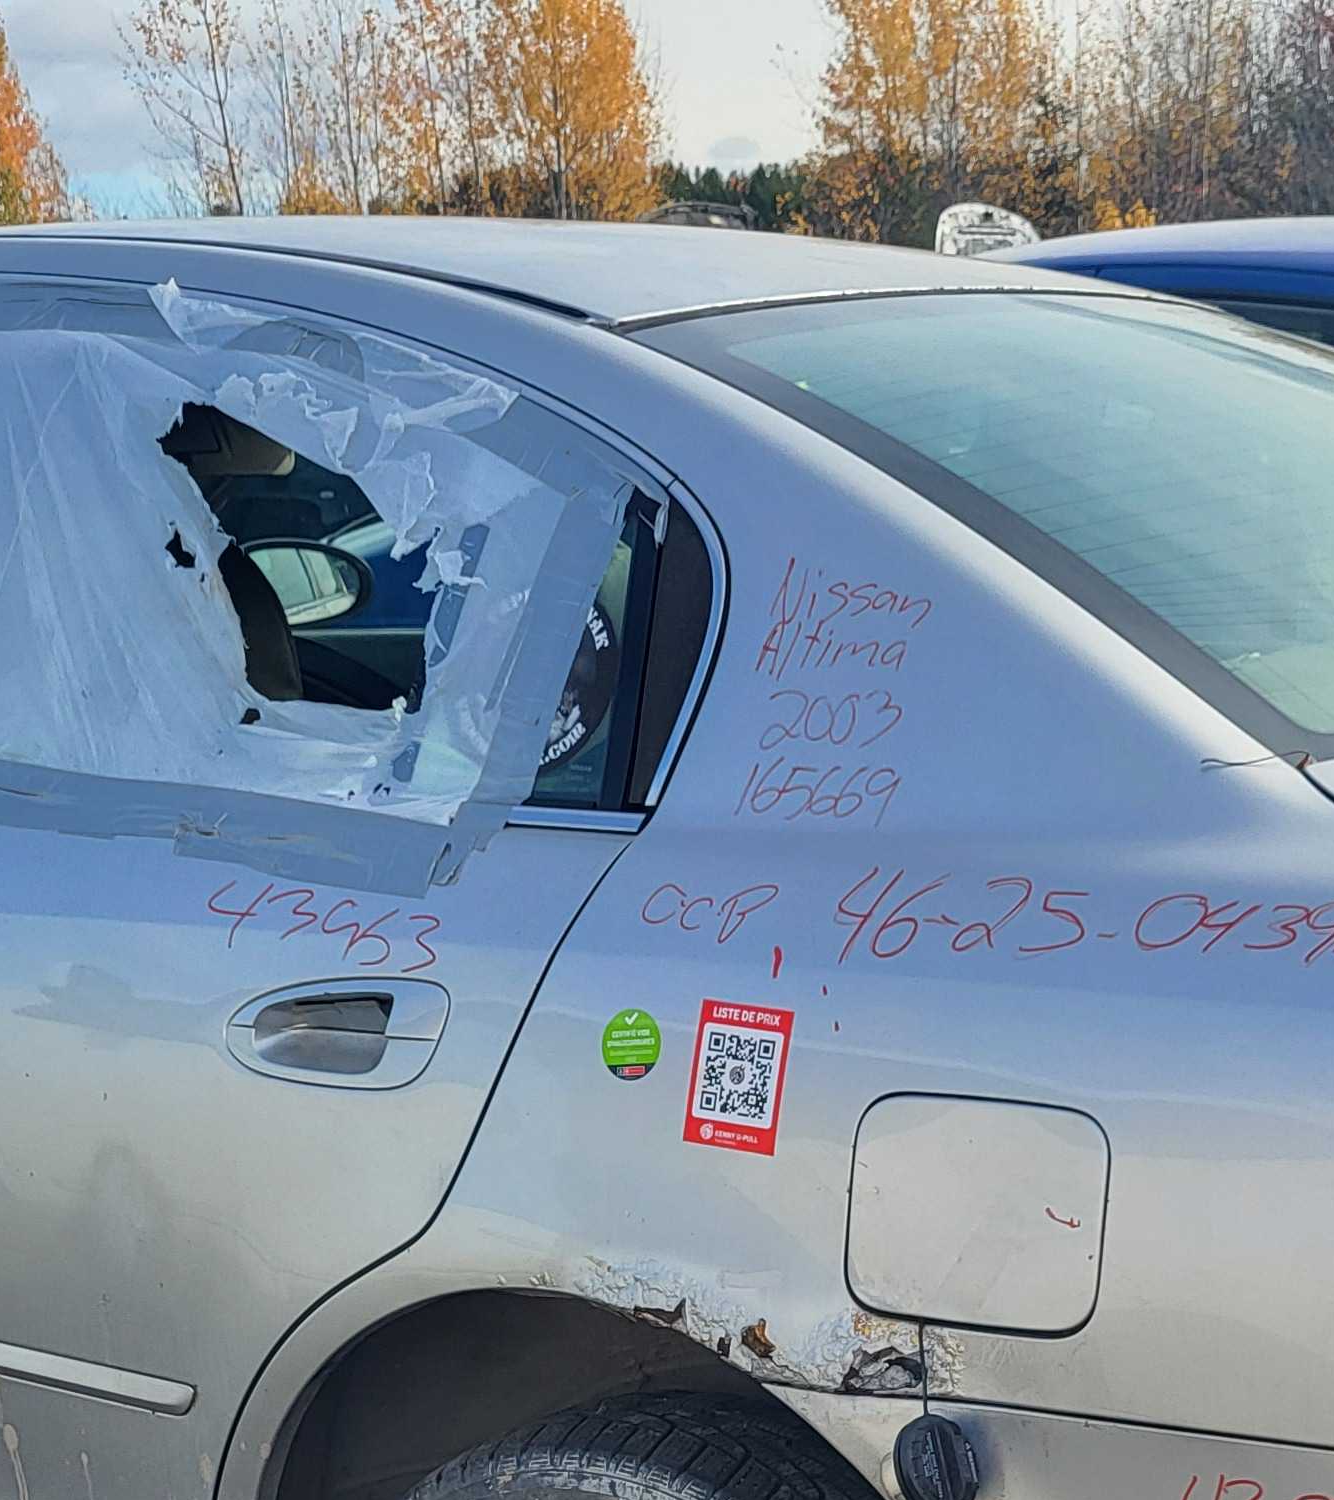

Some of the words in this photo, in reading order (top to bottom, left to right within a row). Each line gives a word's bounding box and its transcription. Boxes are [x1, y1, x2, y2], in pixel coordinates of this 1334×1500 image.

[769, 556, 933, 629] Nissan
[754, 621, 908, 682] Altima
[759, 688, 904, 751] 2003
[733, 755, 904, 829] 165669
[206, 879, 443, 974] 43963
[713, 1006, 742, 1022] LISTE
[741, 1009, 757, 1023] DE
[757, 1012, 782, 1027] PRIX
